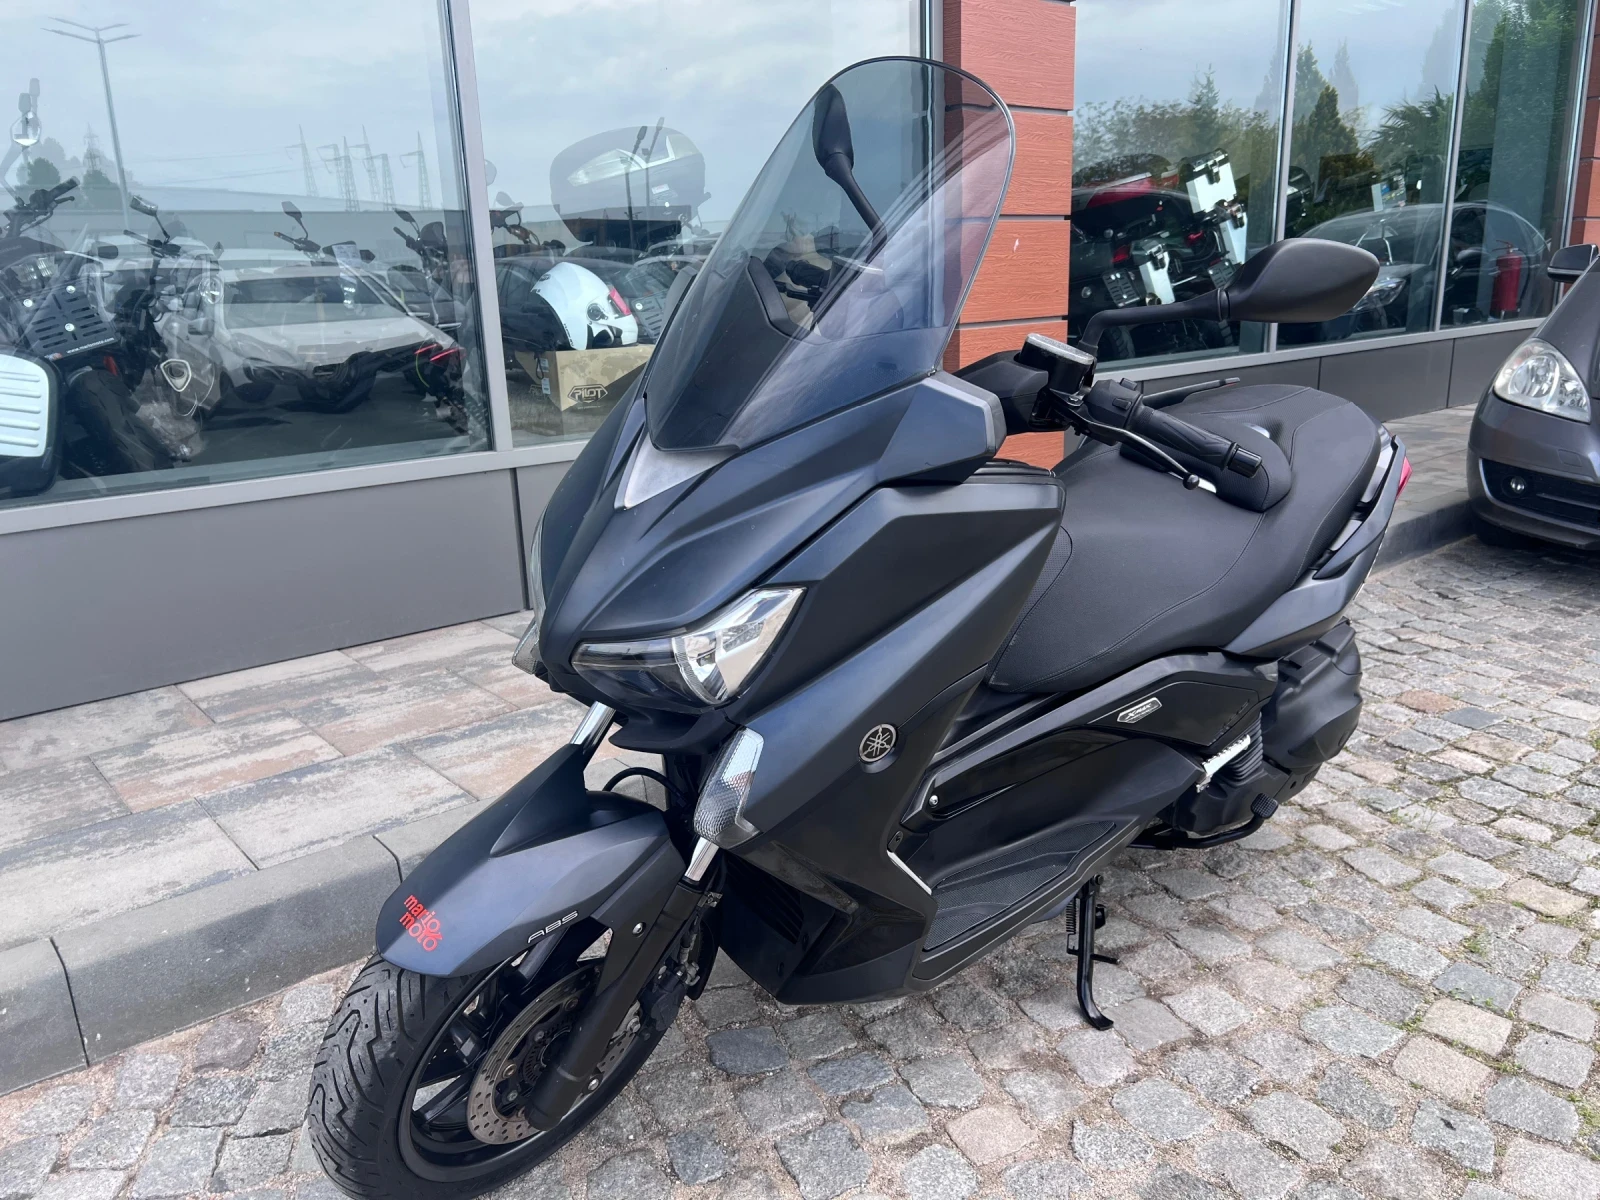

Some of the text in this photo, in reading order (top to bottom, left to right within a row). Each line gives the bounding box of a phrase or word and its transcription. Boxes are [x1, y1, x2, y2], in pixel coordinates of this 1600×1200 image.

[399, 912, 438, 952] moto
[404, 895, 441, 933] mario
[527, 910, 579, 944] ABS
